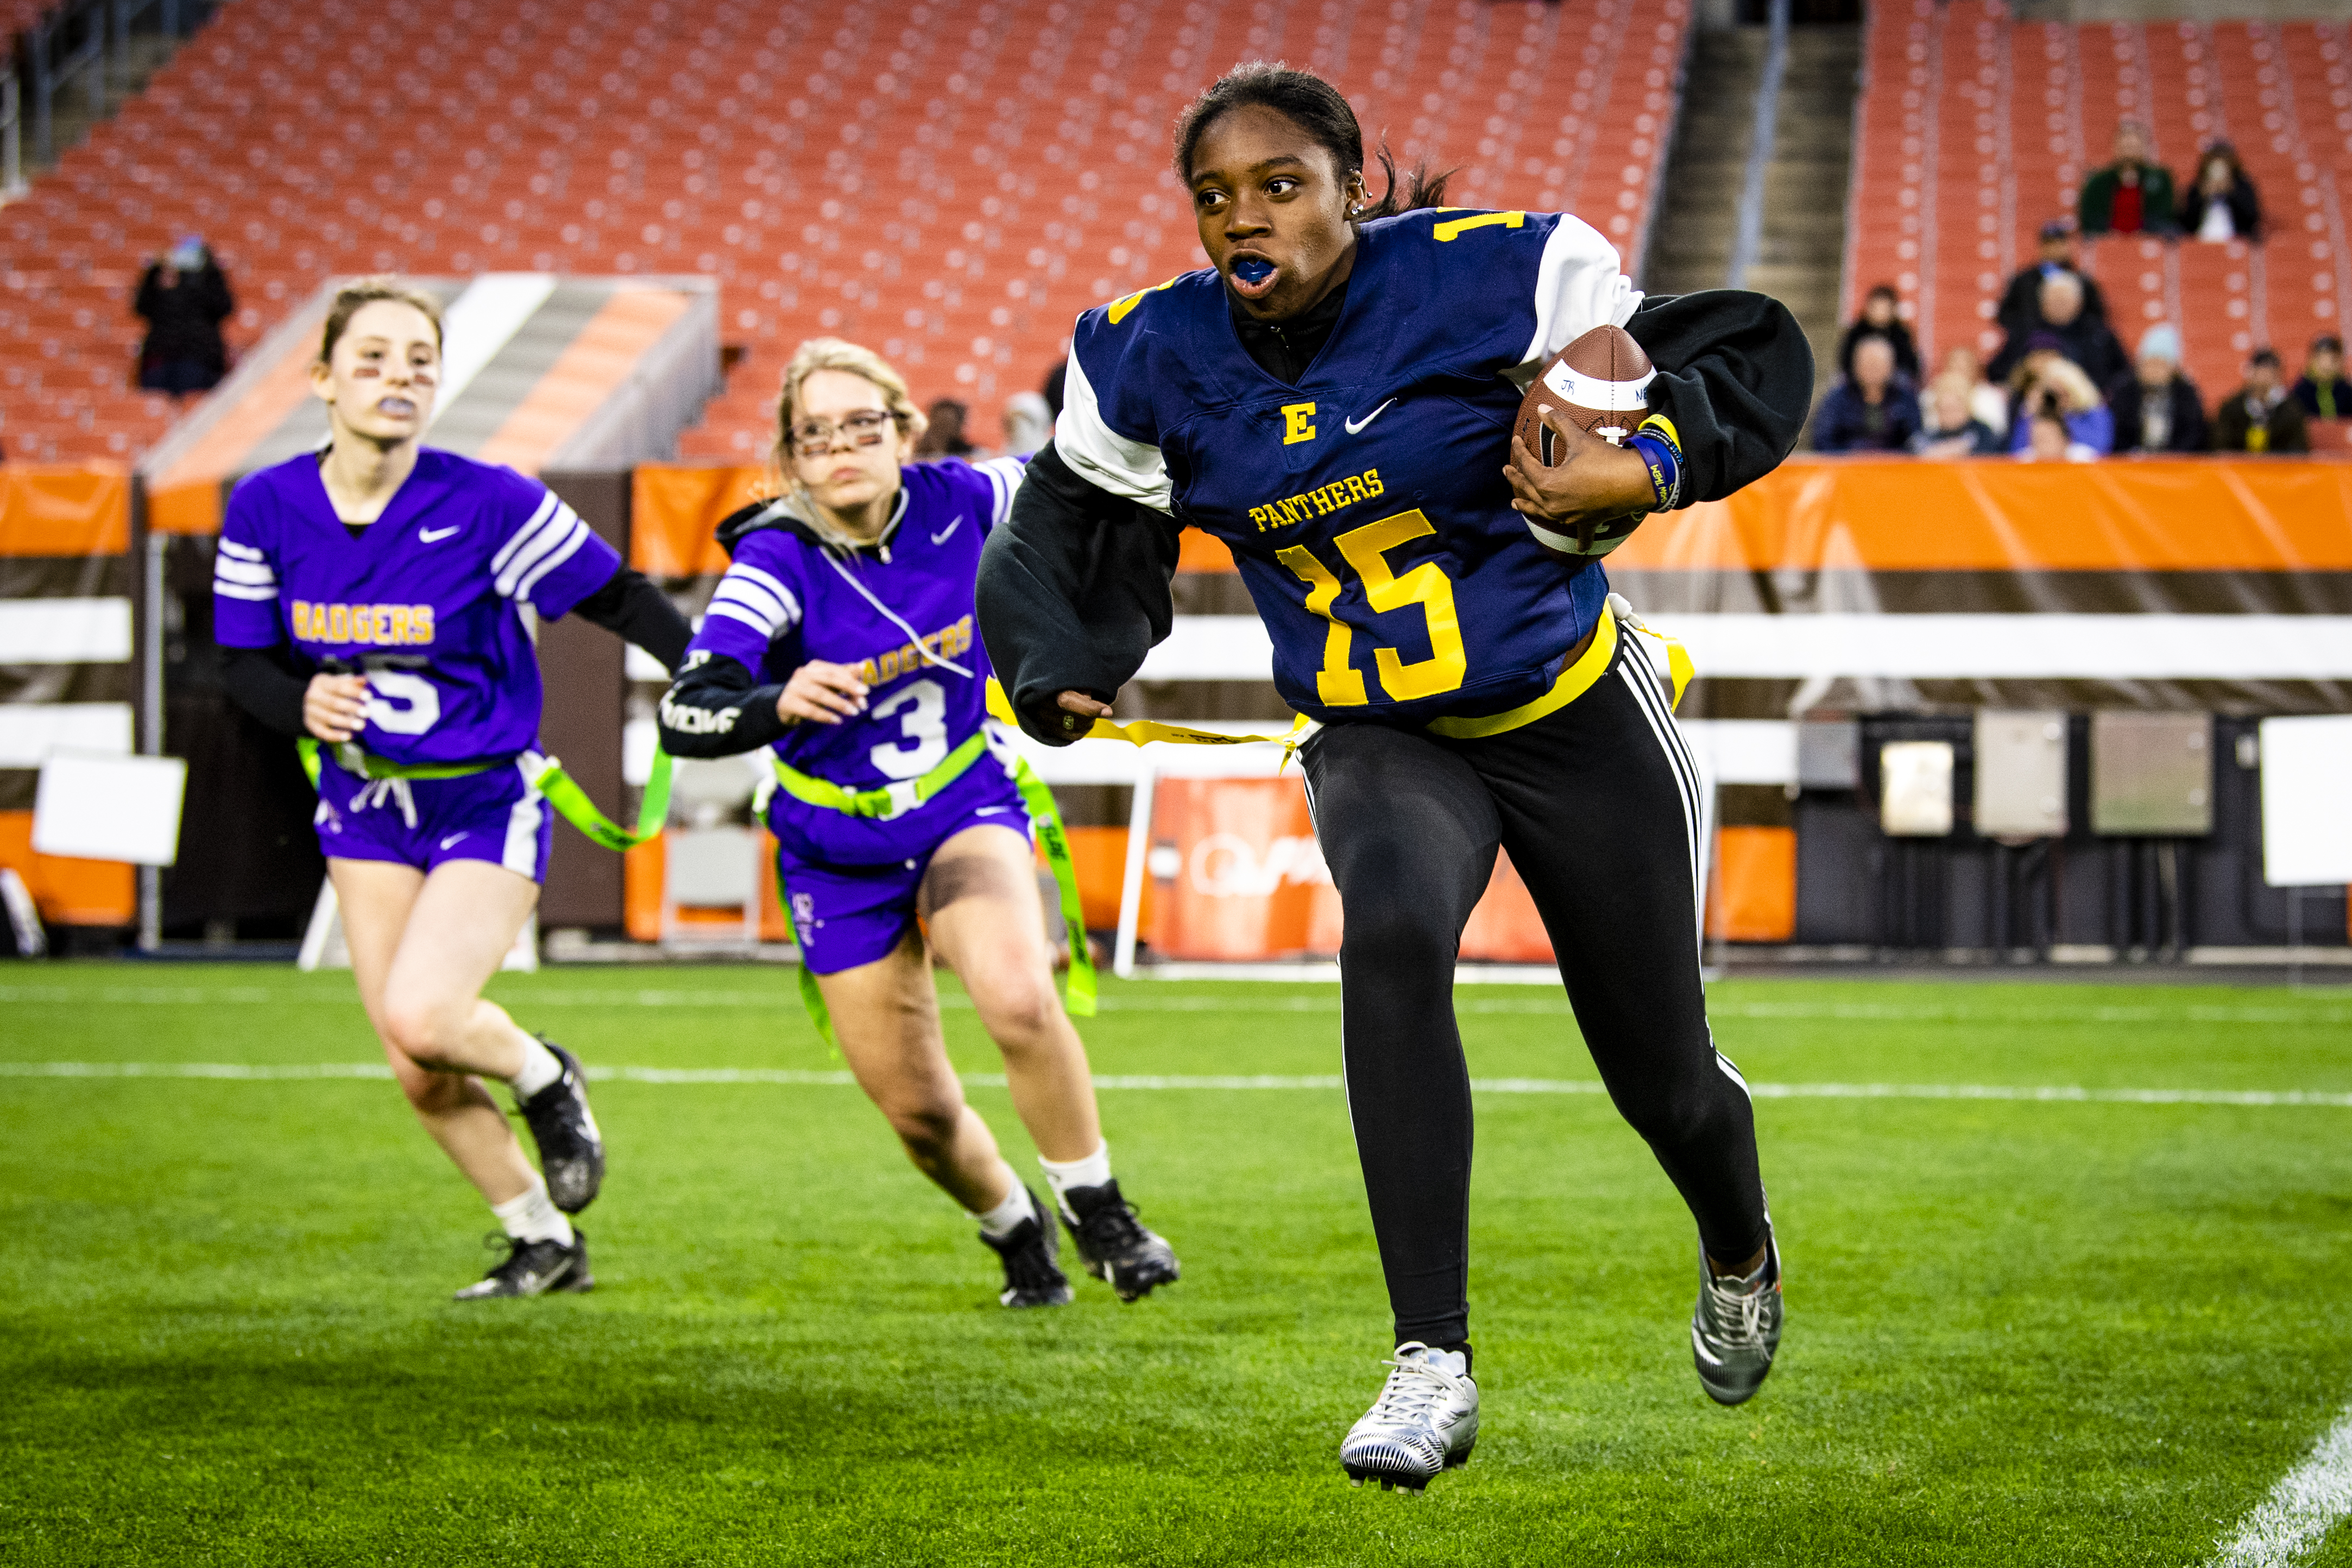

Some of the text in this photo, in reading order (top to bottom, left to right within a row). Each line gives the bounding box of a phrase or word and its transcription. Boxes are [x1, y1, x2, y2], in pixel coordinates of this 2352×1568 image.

[1561, 379, 1575, 395] JR
[1281, 401, 1316, 445] E
[1248, 468, 1385, 533] PANTHERS
[1650, 464, 1665, 486] THEM
[291, 599, 435, 646] BADGERS
[1275, 508, 1467, 707] 15
[860, 614, 973, 686] ADGERS
[869, 678, 949, 780] 3
